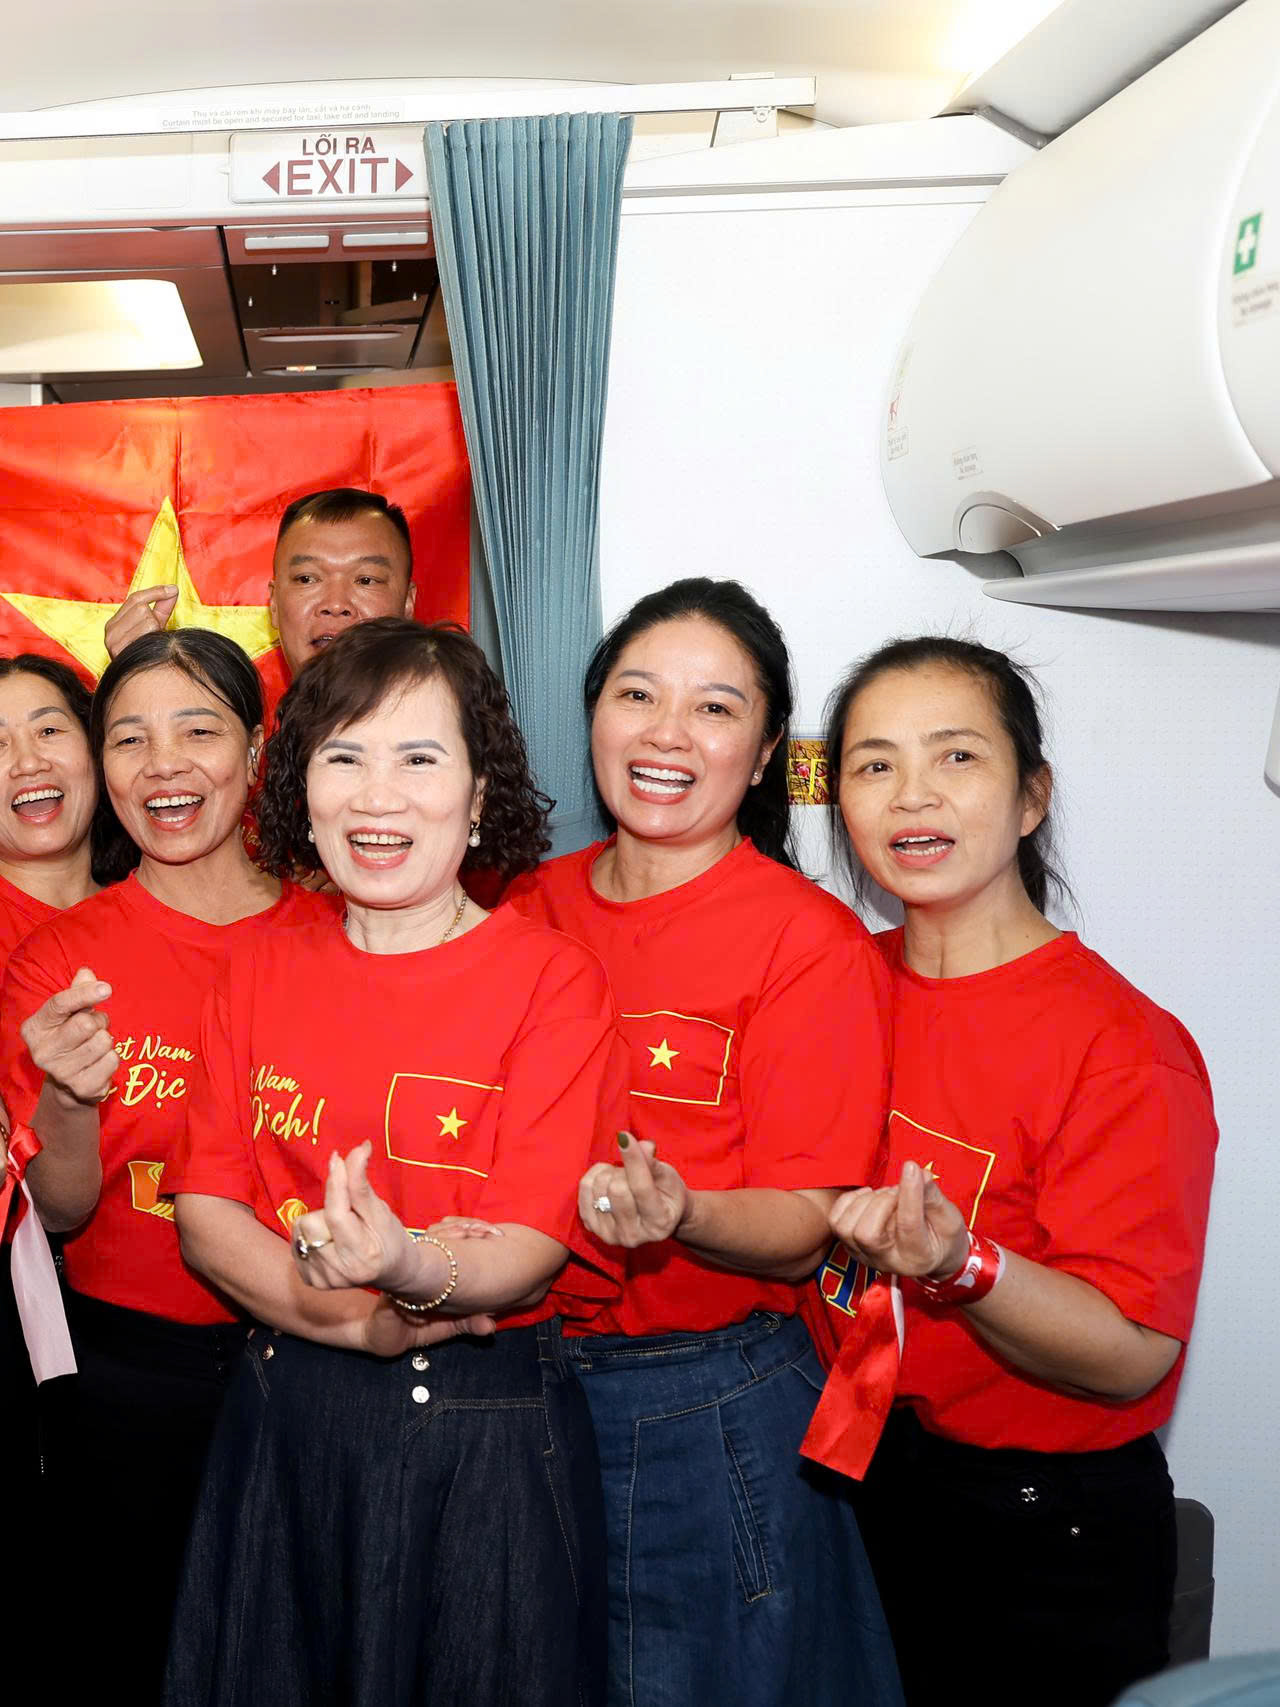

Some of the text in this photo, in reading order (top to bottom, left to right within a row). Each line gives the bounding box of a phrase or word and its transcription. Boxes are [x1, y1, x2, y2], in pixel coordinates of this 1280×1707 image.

[191, 118, 211, 126] must
[223, 118, 244, 126] open
[370, 111, 400, 119] landing
[302, 133, 376, 156] LỐI RA
[287, 157, 389, 196] EXIT
[138, 1034, 196, 1062] Nam
[254, 1064, 300, 1093] Nam
